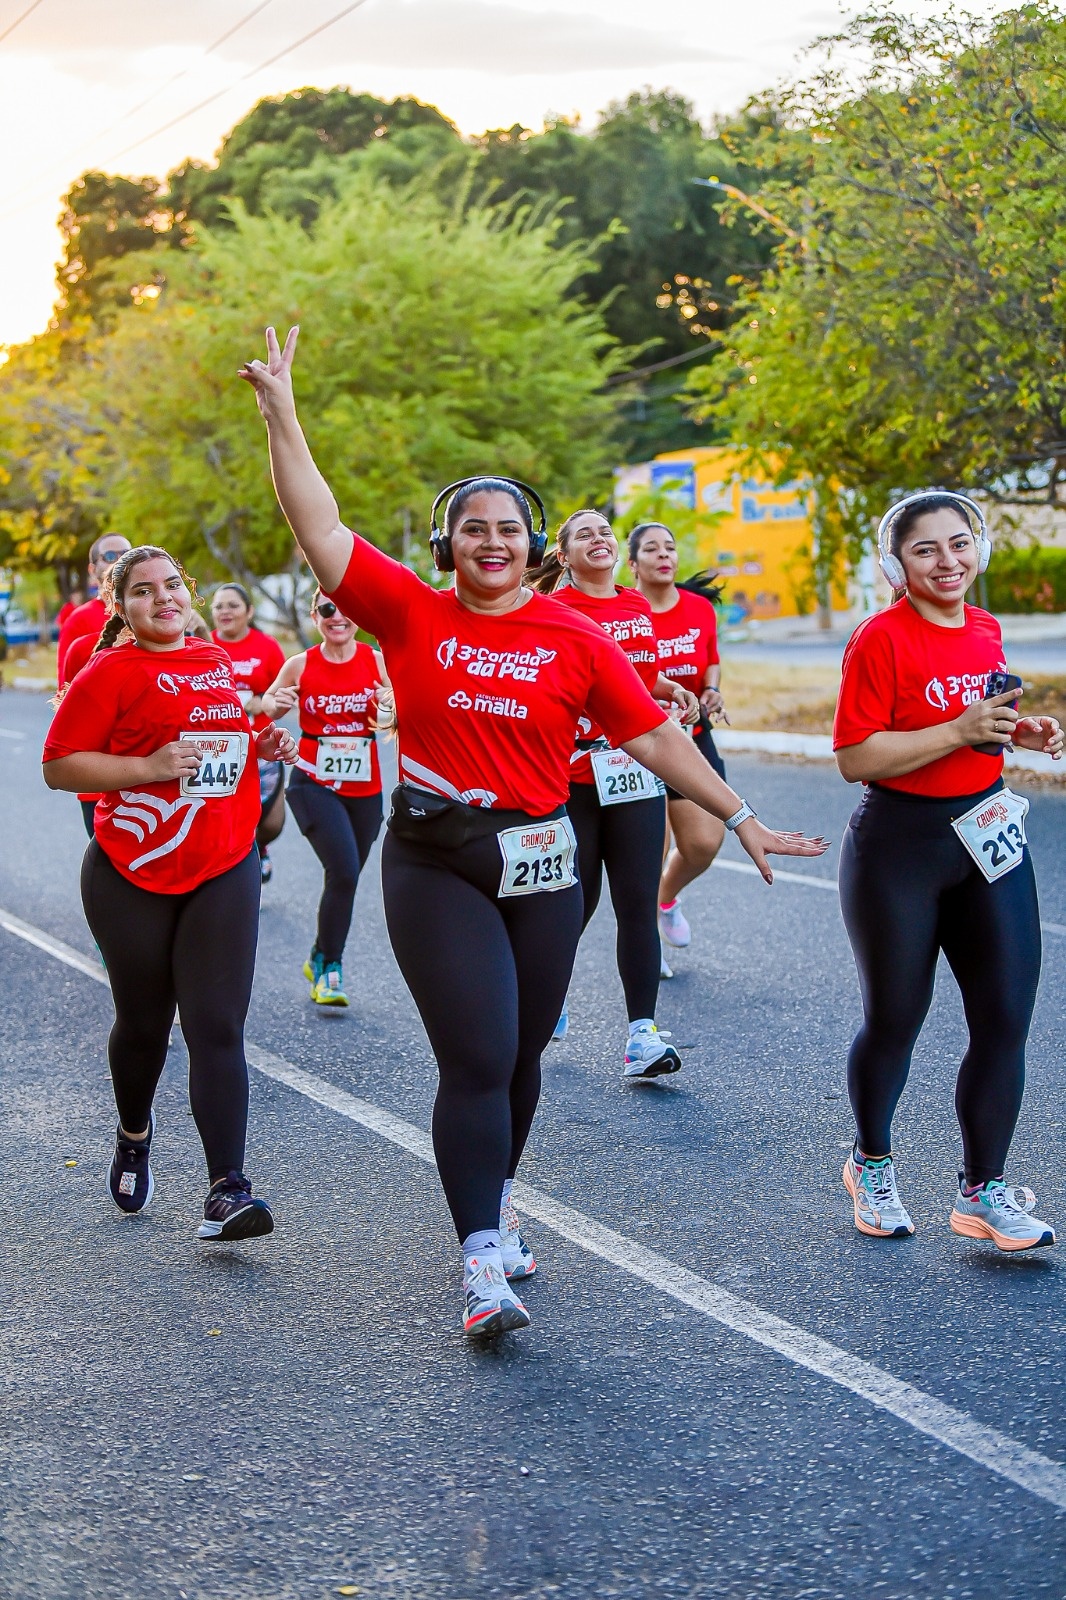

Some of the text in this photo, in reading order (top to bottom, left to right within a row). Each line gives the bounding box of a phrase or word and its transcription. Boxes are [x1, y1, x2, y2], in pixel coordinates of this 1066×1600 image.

[612, 618, 651, 630] Corrida
[614, 626, 653, 641] da Paz
[477, 647, 540, 666] Corrida
[674, 644, 696, 655] Paz
[467, 661, 539, 682] da Paz
[665, 664, 698, 677] malta
[328, 693, 368, 704] Corrida
[962, 689, 980, 705] da
[208, 703, 242, 720] malta
[325, 702, 367, 714] da Paz
[474, 698, 528, 719] malta
[324, 757, 361, 774] 2177
[187, 763, 238, 786] 2445
[605, 771, 645, 795] 2381
[512, 853, 563, 887] 2133
